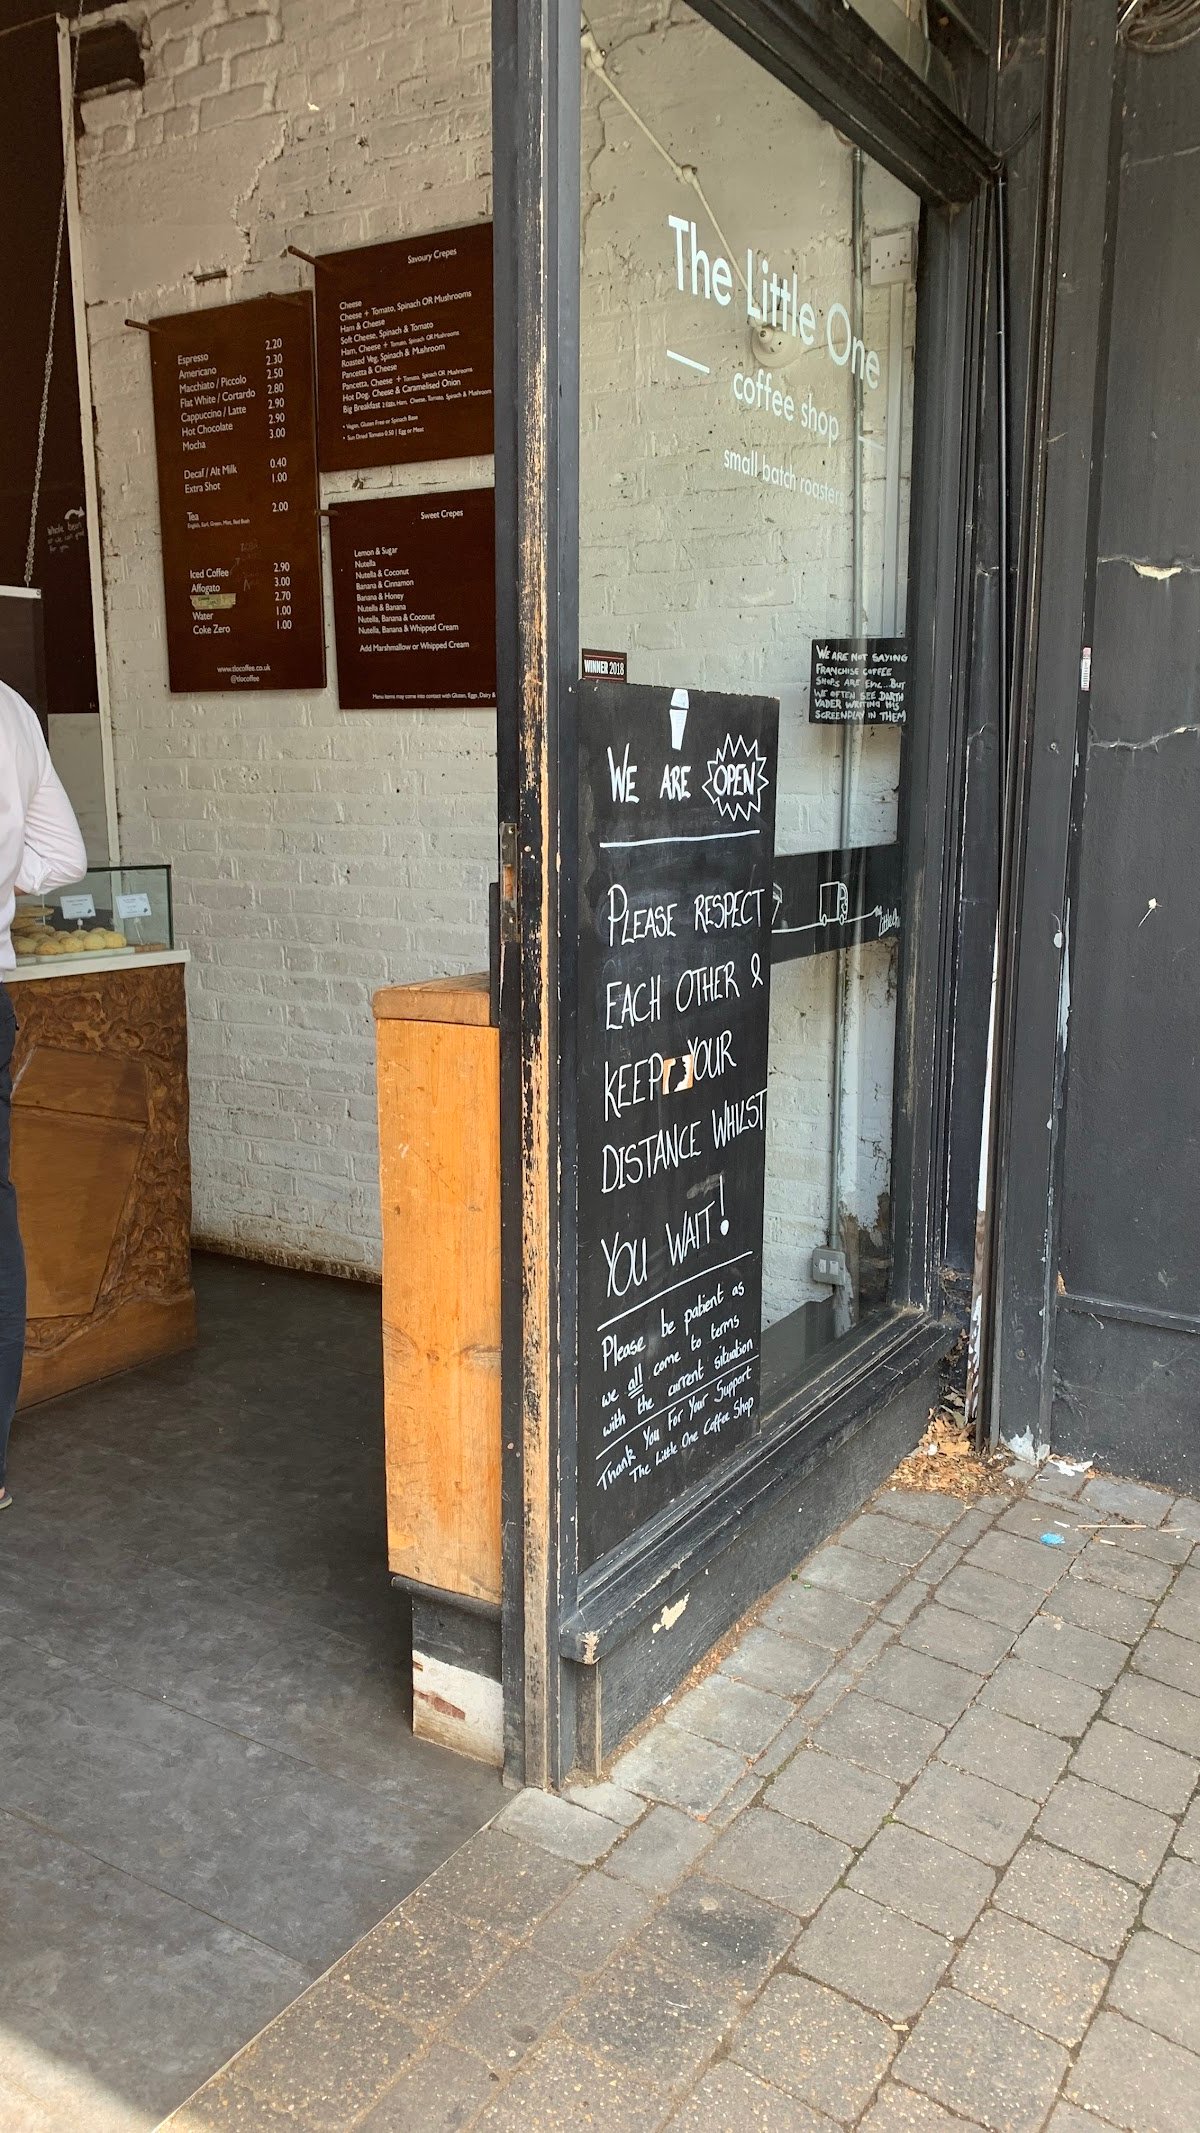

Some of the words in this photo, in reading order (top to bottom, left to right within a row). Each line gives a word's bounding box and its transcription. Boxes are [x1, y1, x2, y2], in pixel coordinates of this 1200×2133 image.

[408, 252, 432, 264] Savoury
[434, 248, 458, 260] Crepes
[340, 300, 362, 310] Cheese
[340, 311, 362, 322] Cheese
[397, 298, 420, 312] Spinach
[422, 297, 434, 306] OR
[434, 290, 472, 304] Mushrooms
[668, 214, 732, 306] The
[747, 248, 816, 346] Little
[826, 302, 880, 389] One
[340, 323, 355, 334] Ham
[362, 318, 385, 330] Cheese
[378, 327, 402, 340] Spinach
[410, 322, 434, 332] Tomato
[265, 338, 282, 350] 2.20
[358, 344, 381, 353] Cheese
[178, 353, 209, 366] Espresso
[266, 353, 283, 366] 2.30
[342, 356, 365, 368] Roasted
[380, 350, 403, 362] Spinach
[412, 344, 445, 355] Mushroom
[178, 367, 217, 380] Americano
[267, 368, 283, 380] 2.50
[342, 369, 367, 379] Pancetta
[374, 364, 397, 373] Cheese
[179, 382, 215, 394] Macchiato
[220, 374, 247, 388] Piccolo
[267, 383, 284, 394] 2.80
[371, 378, 393, 387] Cheese
[343, 394, 354, 402] Hot
[372, 389, 394, 397] Cheese
[402, 381, 440, 394] Caramelised
[442, 378, 461, 387] Onion
[180, 397, 193, 408] Flat
[194, 394, 216, 406] White
[222, 388, 256, 402] Cortardo
[268, 397, 284, 409] 2.90
[343, 405, 352, 414] Big
[354, 401, 380, 412] Breakfast
[733, 369, 795, 422] coffee
[801, 394, 839, 447] shop
[181, 408, 222, 424] Cappuccino
[228, 405, 247, 418] Latte
[269, 412, 285, 424] 2.90
[182, 427, 196, 437] Hot
[197, 422, 233, 435] Chocolate
[269, 427, 286, 439] 3.00
[182, 439, 206, 451] Mocha
[270, 457, 287, 469] 0.40
[184, 469, 205, 480] Decaf
[210, 466, 221, 476] Alt
[222, 464, 237, 475] Milk
[271, 472, 287, 483] 1.00
[724, 449, 758, 478] small
[762, 455, 796, 491] batch
[800, 476, 844, 506] roasters
[185, 483, 203, 494] Extra
[204, 481, 221, 492] Shot
[272, 501, 289, 512] 2.00
[187, 512, 199, 522] Tea
[420, 512, 440, 520] Sweet
[441, 509, 464, 519] Crepes
[354, 550, 374, 558] Lemon
[382, 546, 398, 556] Sugar
[274, 562, 290, 572] 2.90
[354, 560, 376, 569] Nutella
[190, 570, 204, 579] Iced
[206, 568, 229, 578] Coffee
[356, 571, 376, 580] Nutella
[384, 568, 410, 577] Coconut
[274, 576, 290, 587] 3.00
[356, 582, 377, 590] Banana
[384, 579, 414, 588] Cinnamon
[191, 584, 220, 595] Affogato
[275, 591, 291, 601] 2.70
[356, 593, 377, 602] Banana
[384, 592, 404, 601] Honey
[276, 605, 292, 616] 1.00
[357, 604, 378, 613] Nutella
[385, 603, 406, 611] Banana
[192, 611, 214, 620] Water
[409, 613, 435, 621] Coconut
[193, 624, 212, 634] Coke
[214, 624, 230, 634] Zero
[276, 620, 292, 630] 1.00
[382, 625, 402, 634] Banana
[410, 624, 437, 635] Whipped
[438, 622, 459, 632] Cream
[373, 642, 411, 652] Marshmallow
[420, 641, 447, 651] Whipped
[448, 640, 470, 648] Cream
[832, 651, 850, 661] ARE
[851, 653, 868, 662] NOT
[872, 653, 908, 662] SAYING
[217, 664, 271, 673] www.tlocoffee.co.uk
[584, 660, 608, 674] WINNER
[609, 662, 624, 676] 2018
[816, 663, 860, 676] FRANCHISE
[862, 667, 893, 677] COFFEE
[230, 675, 260, 684] @tlocoffee
[816, 676, 840, 688] SHOPS
[844, 679, 860, 688] ARE
[830, 690, 856, 700] OFTEN
[861, 691, 876, 701] SEE
[878, 692, 904, 702] DARTH
[815, 699, 842, 709] VADER
[885, 701, 900, 711] HIS
[815, 710, 865, 720] SCREENPLAY
[868, 710, 876, 719] IN
[879, 710, 907, 723] THEM
[606, 742, 640, 803] WE
[659, 764, 692, 801] ARE
[713, 761, 756, 796] OPEN
[608, 883, 678, 946] PLEASE
[694, 889, 765, 933] RESPECT
[606, 974, 661, 1030] EACH
[676, 961, 740, 1012] OTHER
[605, 1052, 663, 1122] KEEP
[687, 1030, 737, 1081] YOUR
[601, 1121, 702, 1194] DISTANCE
[712, 1088, 767, 1149] WHILST
[601, 1231, 647, 1297] YOU
[666, 1175, 729, 1266] WAIT!
[601, 1334, 646, 1372] Please
[661, 1308, 676, 1338] be
[684, 1283, 724, 1336] patient
[732, 1281, 745, 1297] as
[602, 1389, 620, 1408] we
[628, 1362, 642, 1391] all
[653, 1351, 682, 1377] come
[691, 1334, 702, 1352] to
[711, 1314, 740, 1340] terms
[602, 1408, 626, 1437] with
[638, 1394, 655, 1415] the
[668, 1358, 705, 1396] current
[714, 1338, 753, 1370] situation
[597, 1444, 637, 1490] Thank
[643, 1425, 660, 1450] You
[668, 1406, 684, 1431] For
[689, 1393, 709, 1420] Your
[714, 1366, 752, 1402] Support
[629, 1462, 652, 1483] The
[655, 1441, 679, 1466] Little
[682, 1430, 699, 1449] One
[704, 1411, 730, 1436] Coffee
[733, 1396, 754, 1418] Shop
